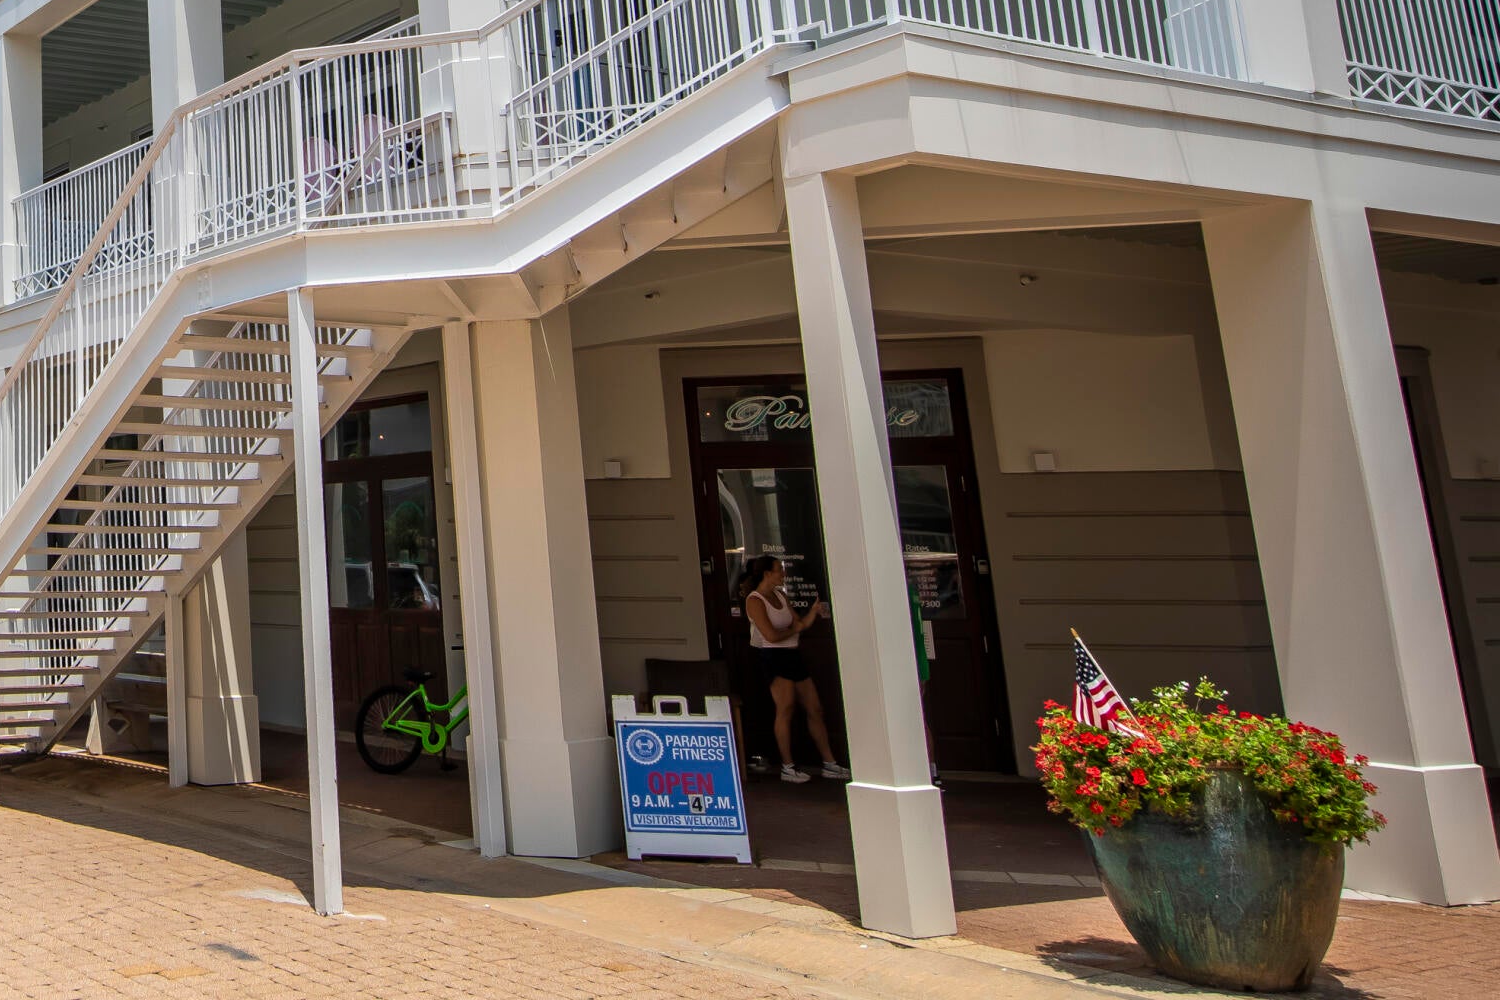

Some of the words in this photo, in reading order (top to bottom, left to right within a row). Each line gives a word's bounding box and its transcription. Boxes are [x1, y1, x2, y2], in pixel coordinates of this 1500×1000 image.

[762, 544, 786, 553] Rates
[665, 735, 728, 749] PARADISE
[672, 748, 725, 761] FITNESS
[647, 771, 715, 796] OPEN
[631, 794, 641, 808] 9
[644, 795, 674, 808] A.M.
[704, 796, 735, 810] P.M.
[635, 814, 681, 826] VISITORS
[684, 816, 735, 827] WELCOME
